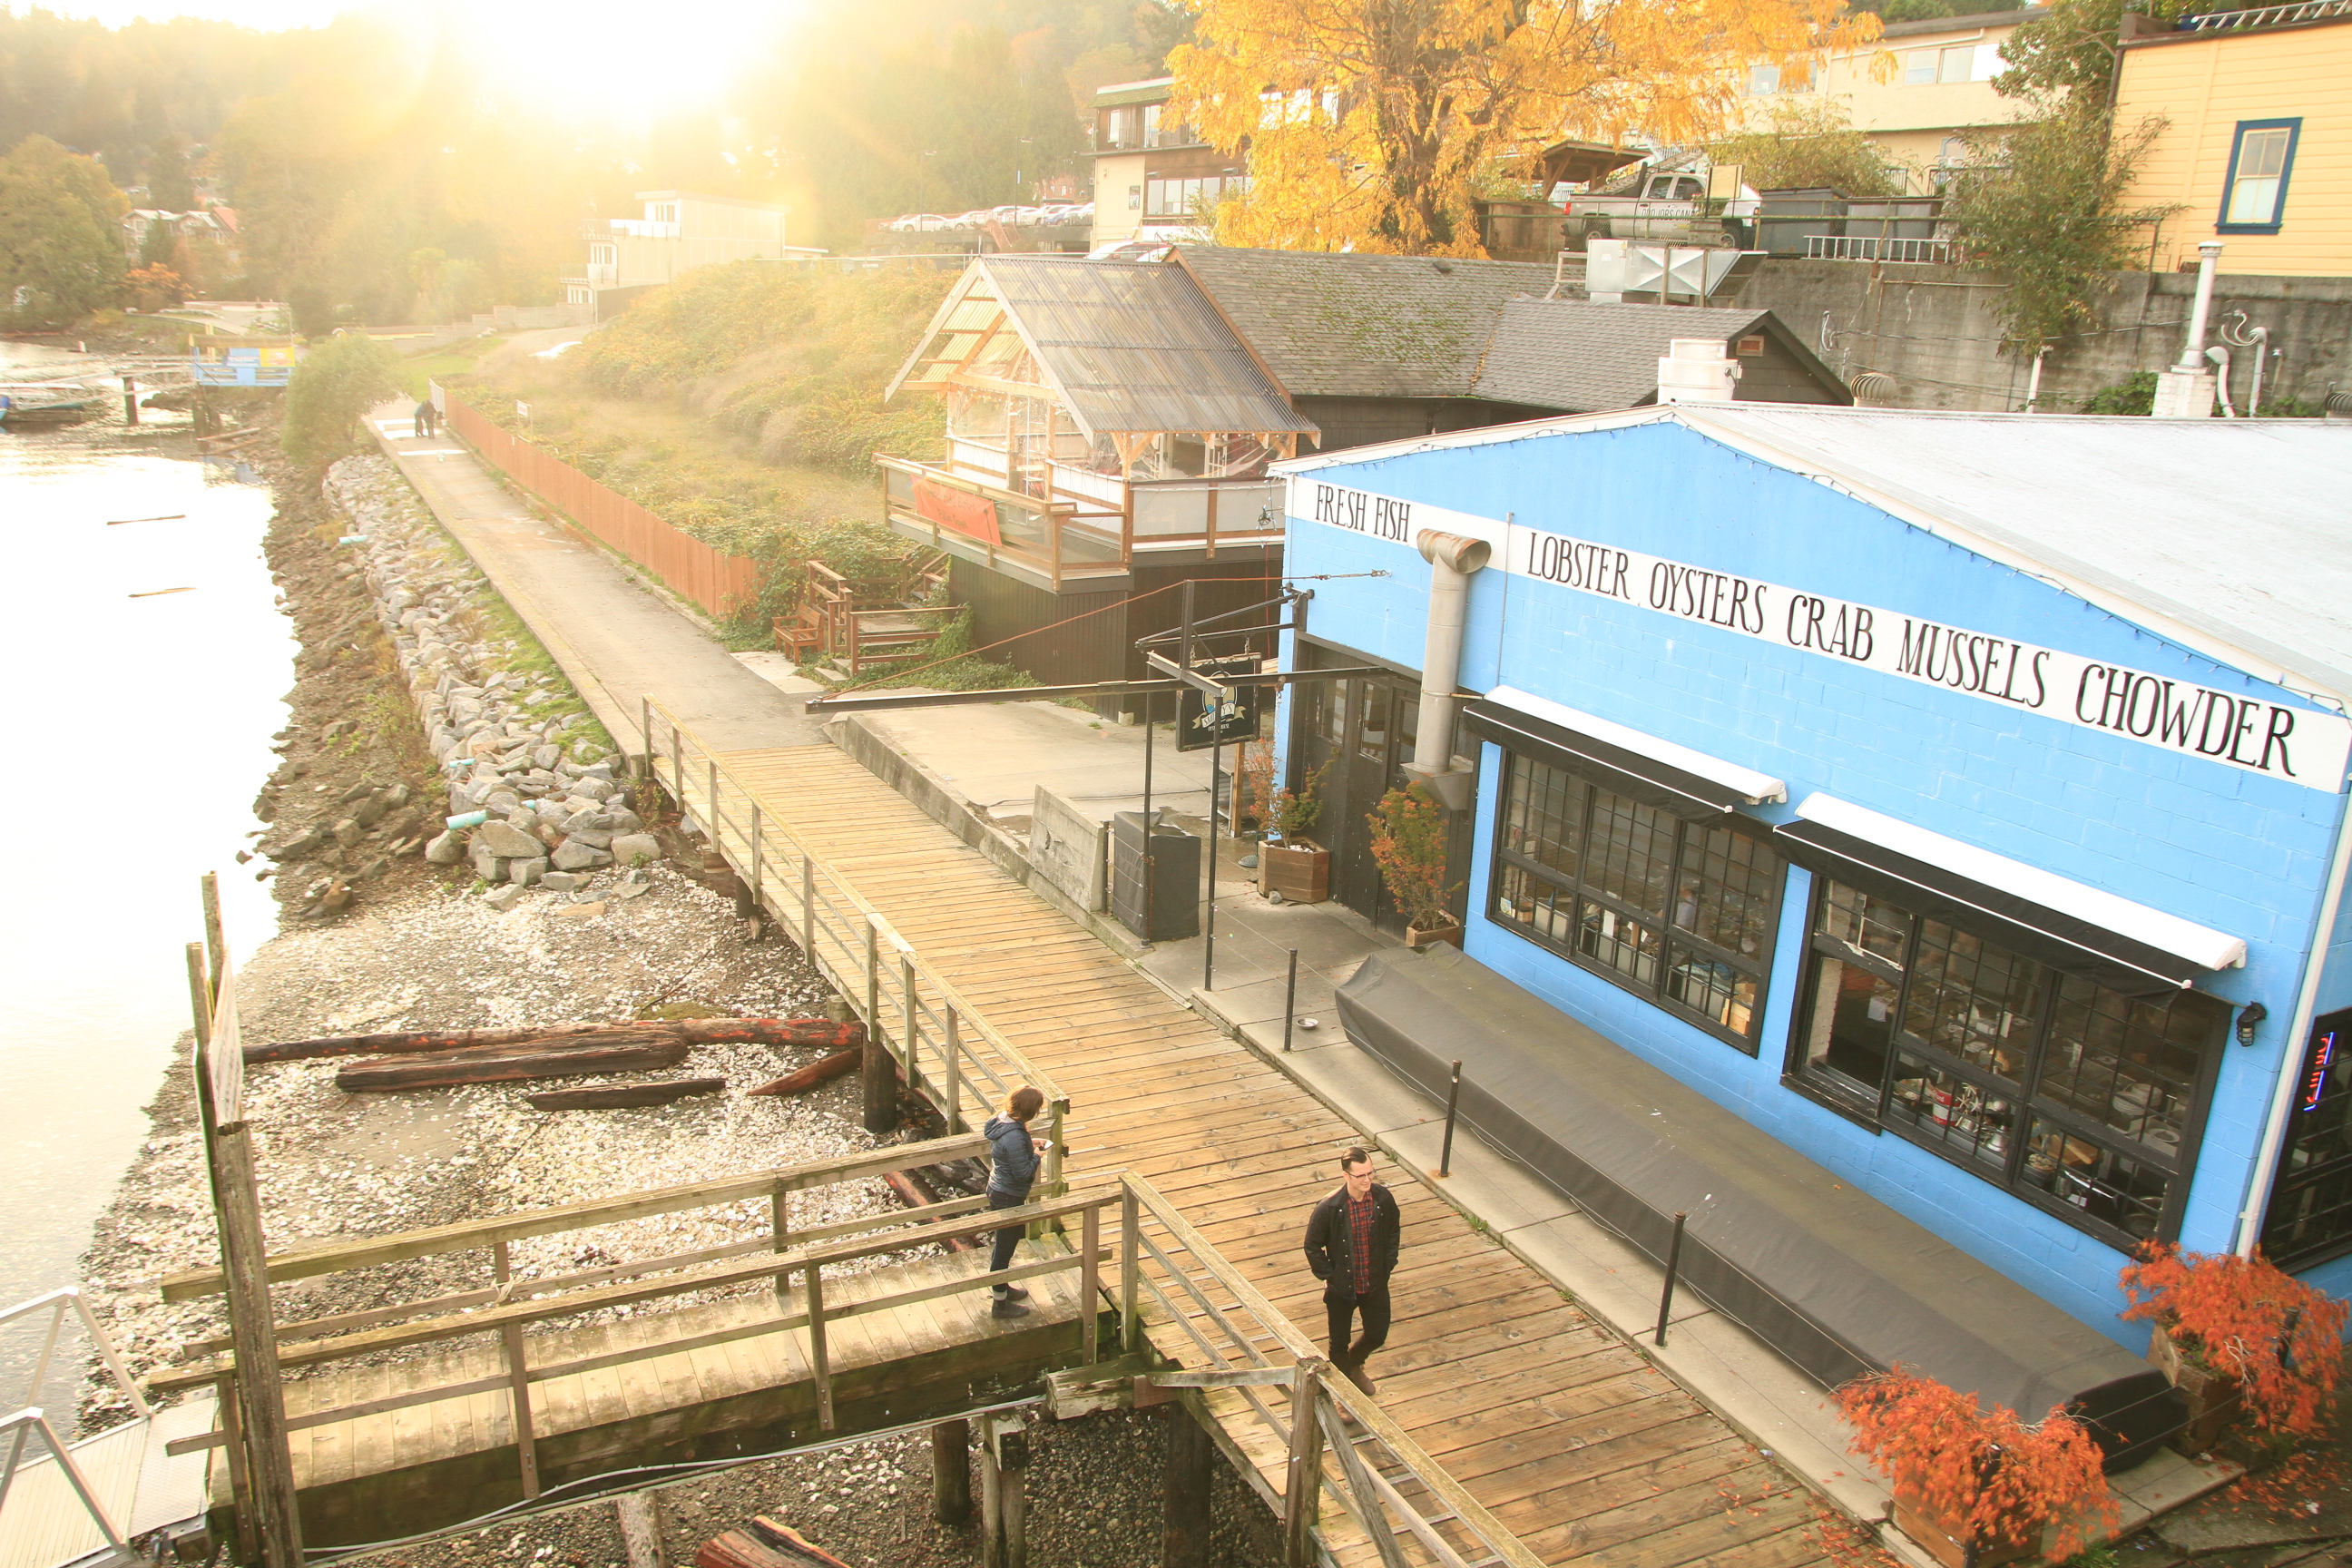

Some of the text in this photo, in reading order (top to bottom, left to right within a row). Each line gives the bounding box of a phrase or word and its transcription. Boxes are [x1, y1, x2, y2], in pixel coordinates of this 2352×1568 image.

[1315, 484, 2297, 778] FRESH FISH LOBSTER OYSTERS CRAB MUSSELS CHOWDER
